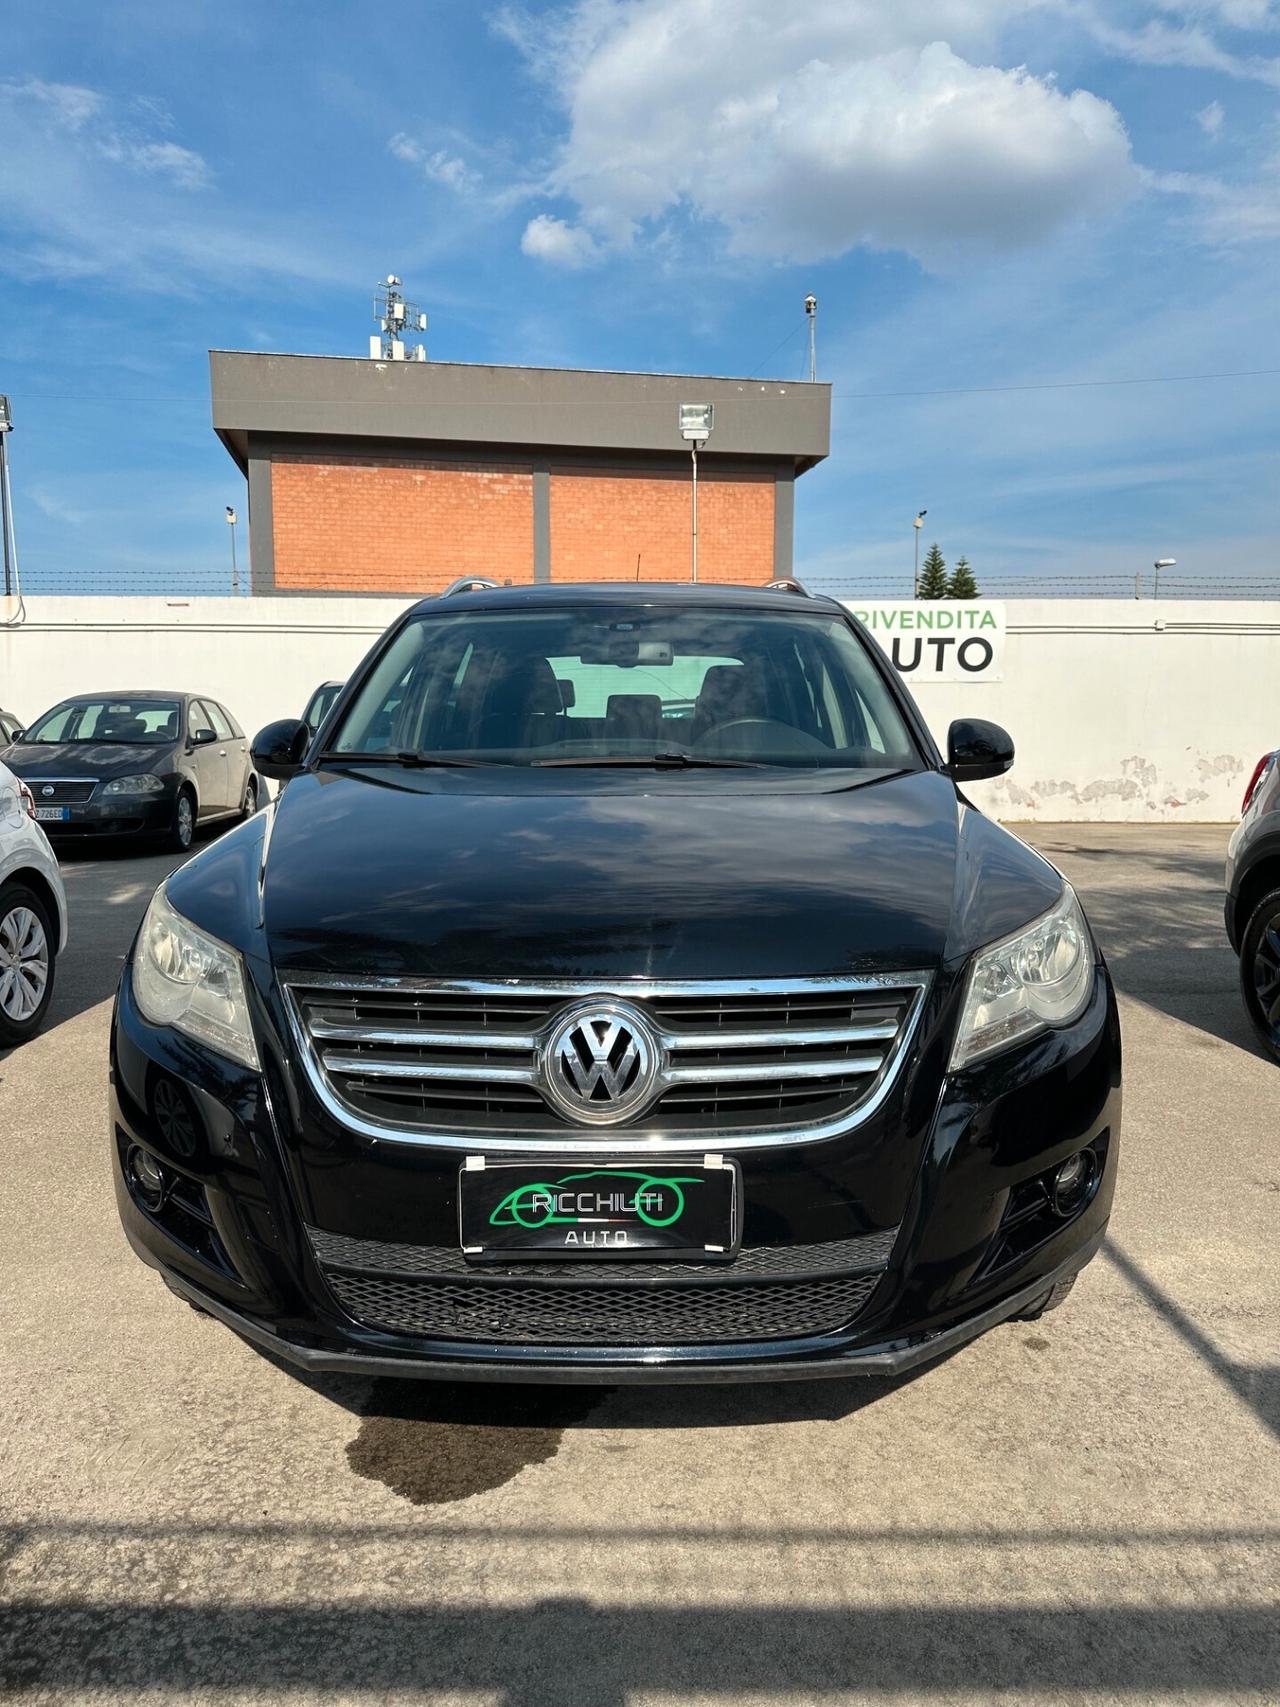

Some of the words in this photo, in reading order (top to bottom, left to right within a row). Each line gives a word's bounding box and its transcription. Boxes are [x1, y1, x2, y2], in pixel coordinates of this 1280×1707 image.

[891, 636, 993, 672] UTO
[532, 1193, 663, 1213] RICCHIUTI
[564, 1230, 628, 1245] AUTO
